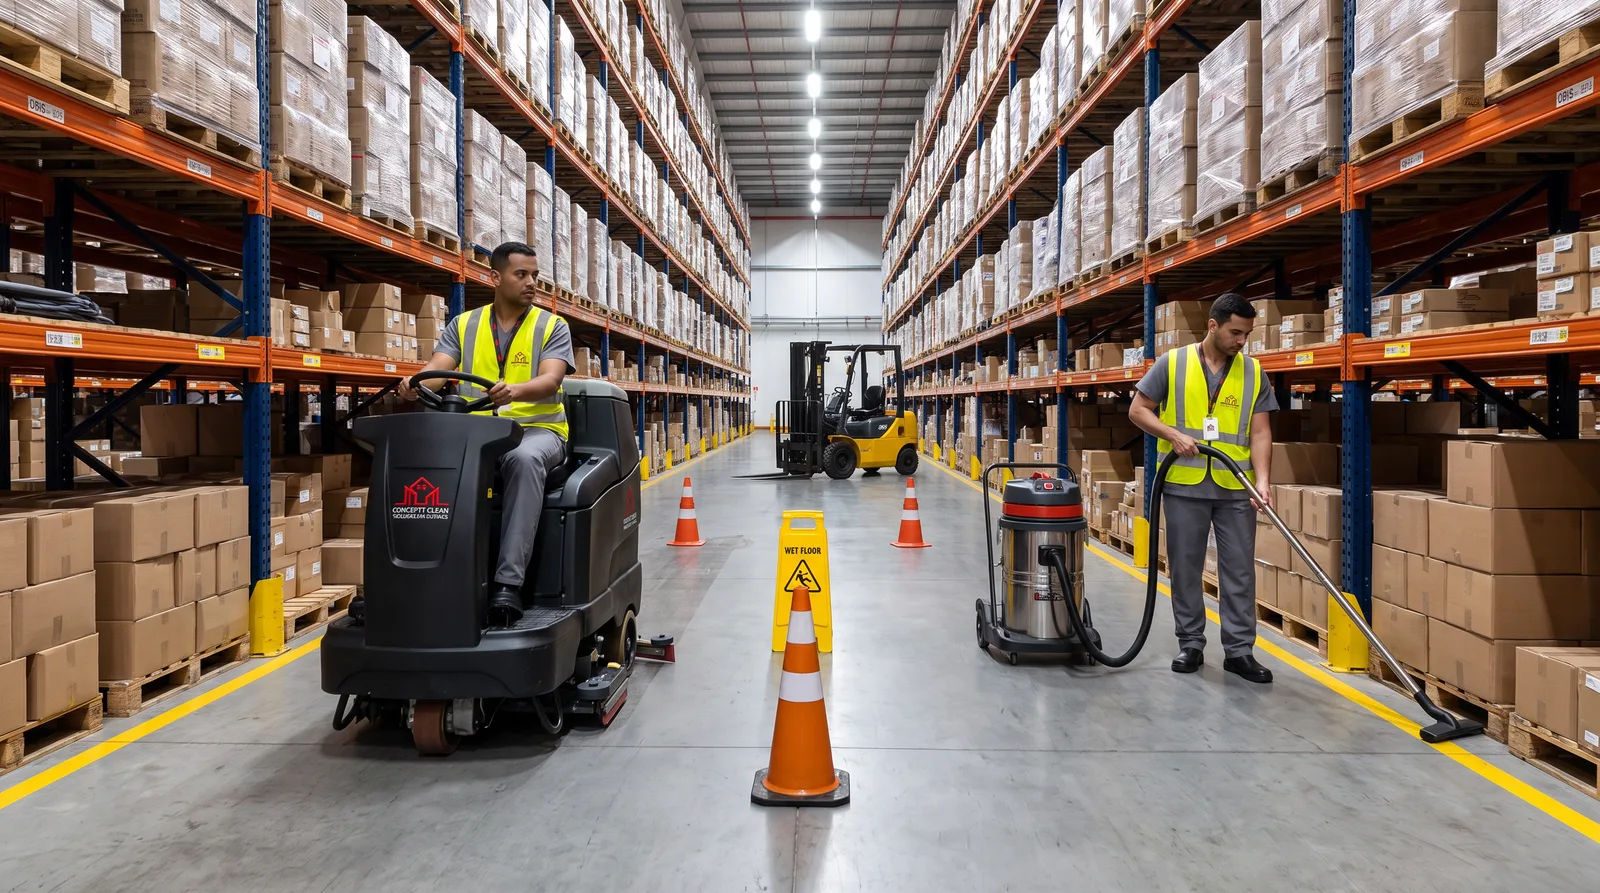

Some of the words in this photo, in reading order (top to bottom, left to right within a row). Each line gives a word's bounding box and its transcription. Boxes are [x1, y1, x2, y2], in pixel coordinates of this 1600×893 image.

[392, 506, 426, 514] CONCEPTT
[784, 546, 799, 555] WET
[800, 546, 822, 555] FLOOR
